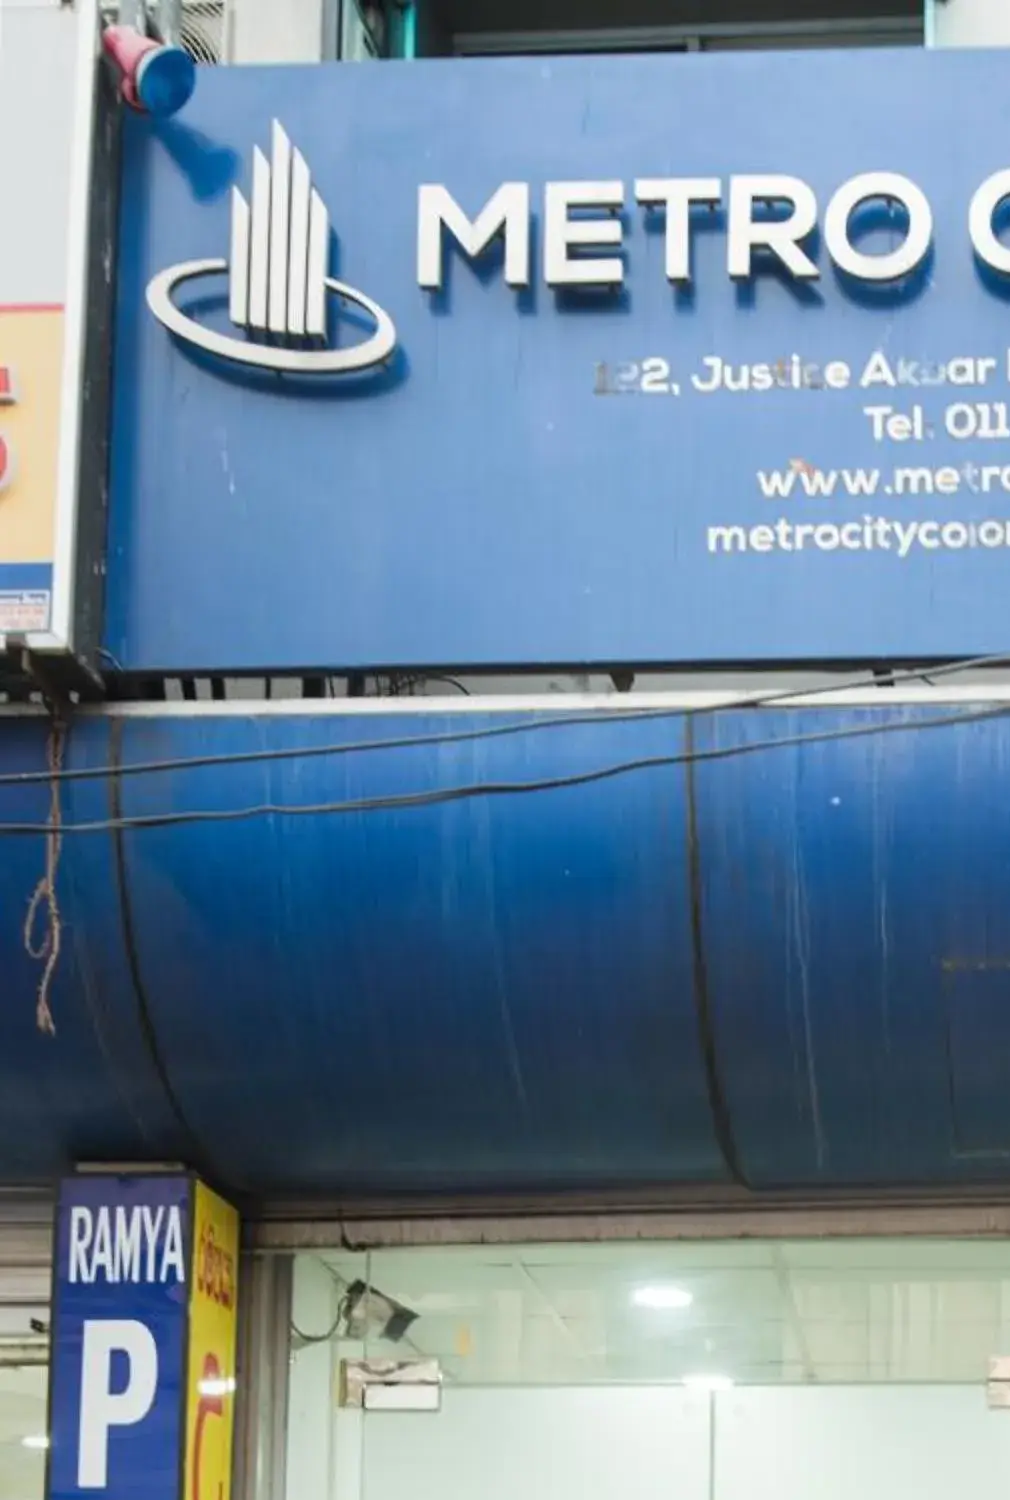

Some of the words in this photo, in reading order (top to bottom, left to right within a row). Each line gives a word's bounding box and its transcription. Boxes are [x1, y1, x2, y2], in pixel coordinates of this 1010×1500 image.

[416, 171, 934, 289] METRO
[944, 402, 1010, 439] 011
[68, 1204, 186, 1285] RAMYA
